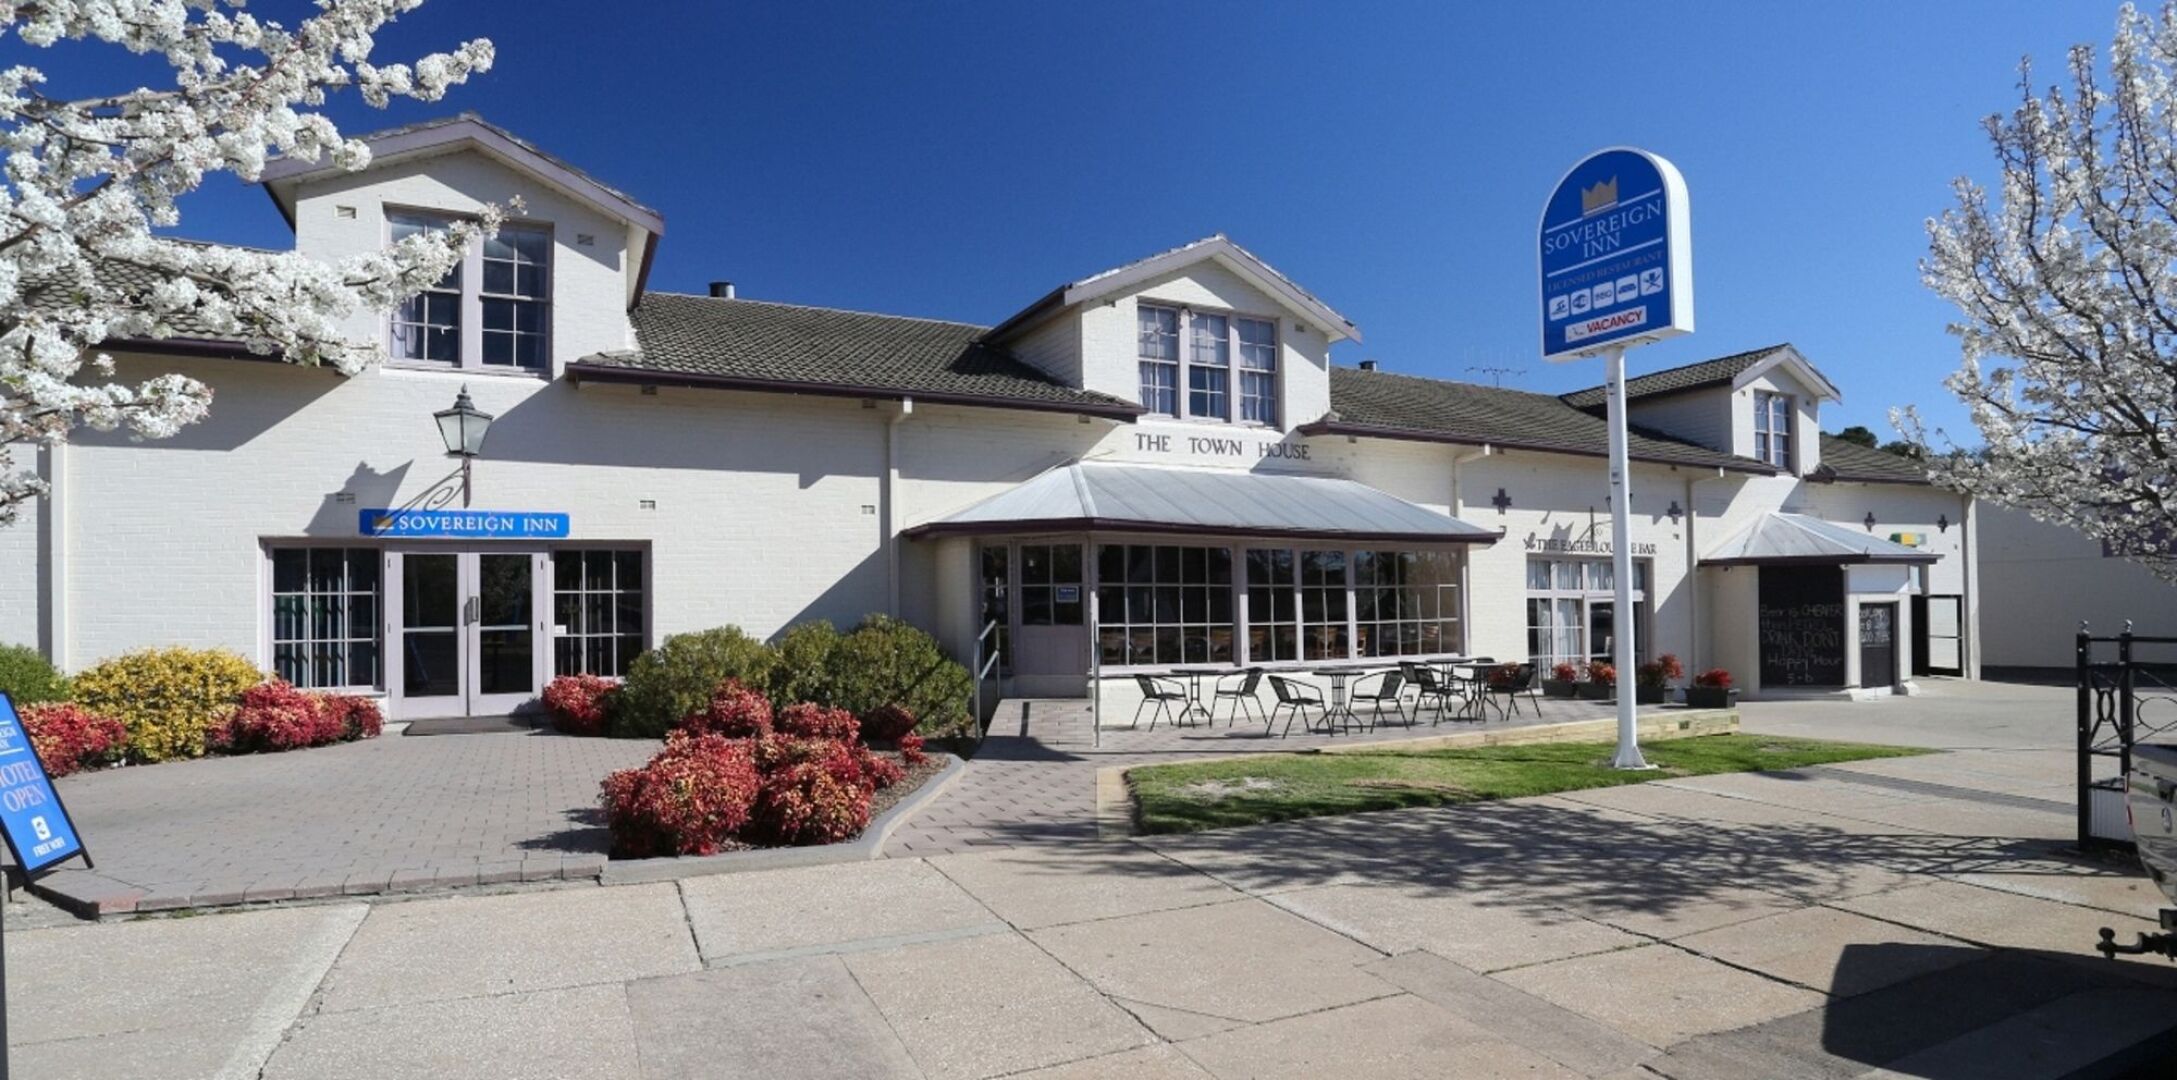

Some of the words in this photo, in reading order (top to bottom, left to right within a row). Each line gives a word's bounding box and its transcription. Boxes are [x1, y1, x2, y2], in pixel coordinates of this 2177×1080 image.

[1545, 199, 1661, 254] SOVEREIGN
[1584, 232, 1621, 258] INN
[1598, 251, 1663, 277] RESTAURANT
[1586, 310, 1643, 333] VACANCY
[1135, 433, 1171, 452] THE
[1188, 437, 1242, 456] TOWN
[1258, 441, 1311, 461] HOUSE
[399, 515, 514, 532] SOVEREIGN
[523, 517, 558, 532] INN
[1535, 538, 1558, 552] THE
[1639, 542, 1657, 555] BAR
[1768, 653, 1808, 671] Happy
[3, 783, 46, 813] OPEN
